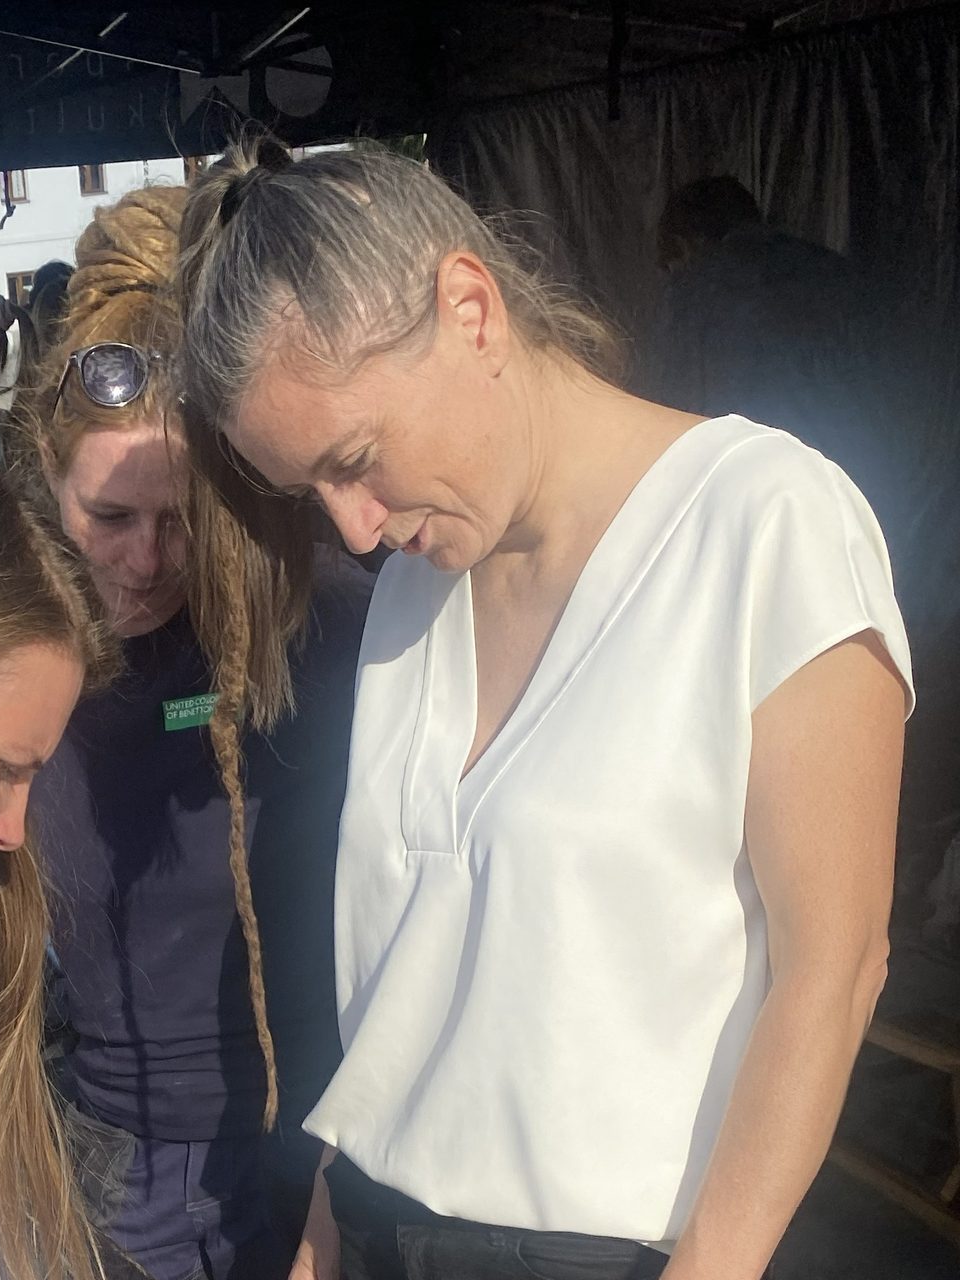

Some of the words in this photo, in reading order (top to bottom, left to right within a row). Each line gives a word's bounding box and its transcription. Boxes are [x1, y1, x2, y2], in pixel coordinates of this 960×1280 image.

[165, 699, 195, 711] UNITED
[195, 696, 216, 706] COLO
[166, 711, 178, 720] OF
